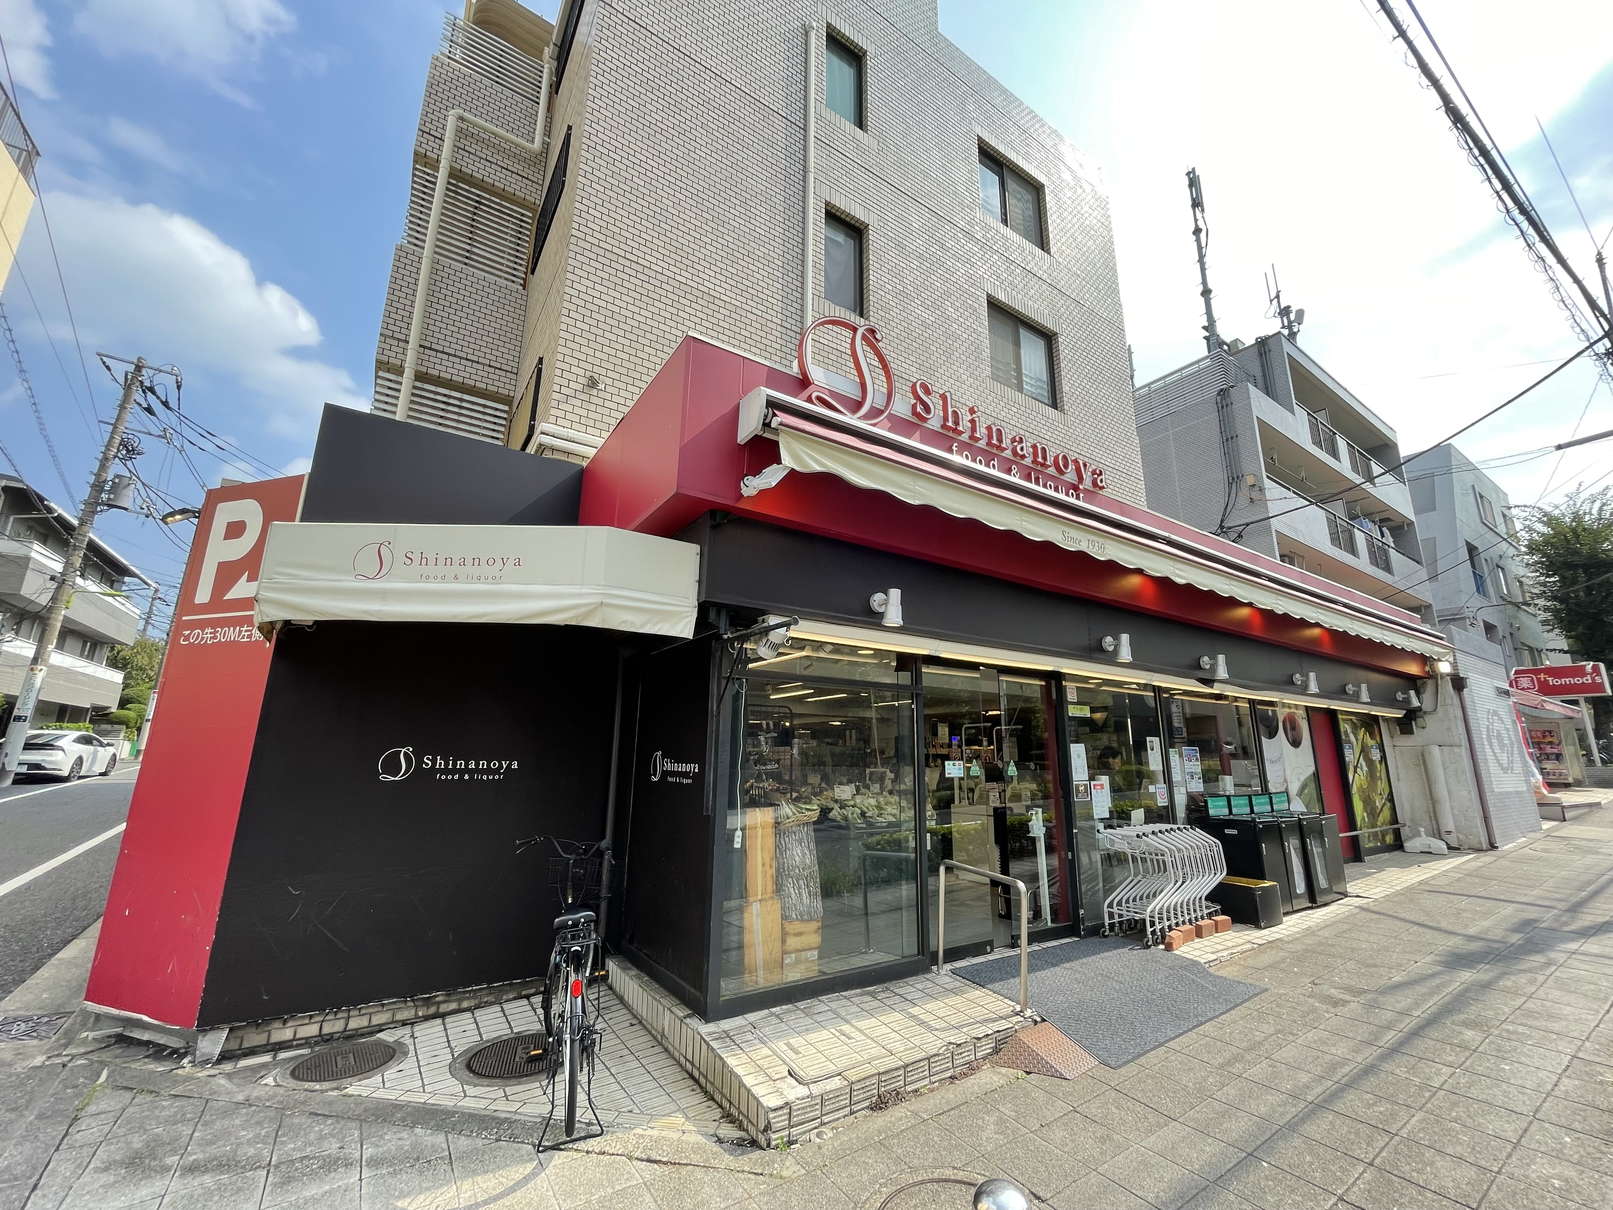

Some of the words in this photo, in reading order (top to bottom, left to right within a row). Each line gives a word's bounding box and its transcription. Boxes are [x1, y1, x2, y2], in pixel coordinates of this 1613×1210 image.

[911, 379, 1107, 490] Shinanoya
[951, 443, 998, 470] food
[1031, 471, 1085, 502] liquor
[1061, 529, 1082, 547] Since
[194, 499, 264, 604] P
[403, 551, 522, 571] Shinanoya
[419, 573, 446, 581] food
[466, 573, 503, 582] liquor
[1546, 673, 1602, 686] Tomod's
[422, 755, 518, 772] Shinanoya
[663, 758, 699, 776] Shinanoya
[474, 773, 504, 781] liquor
